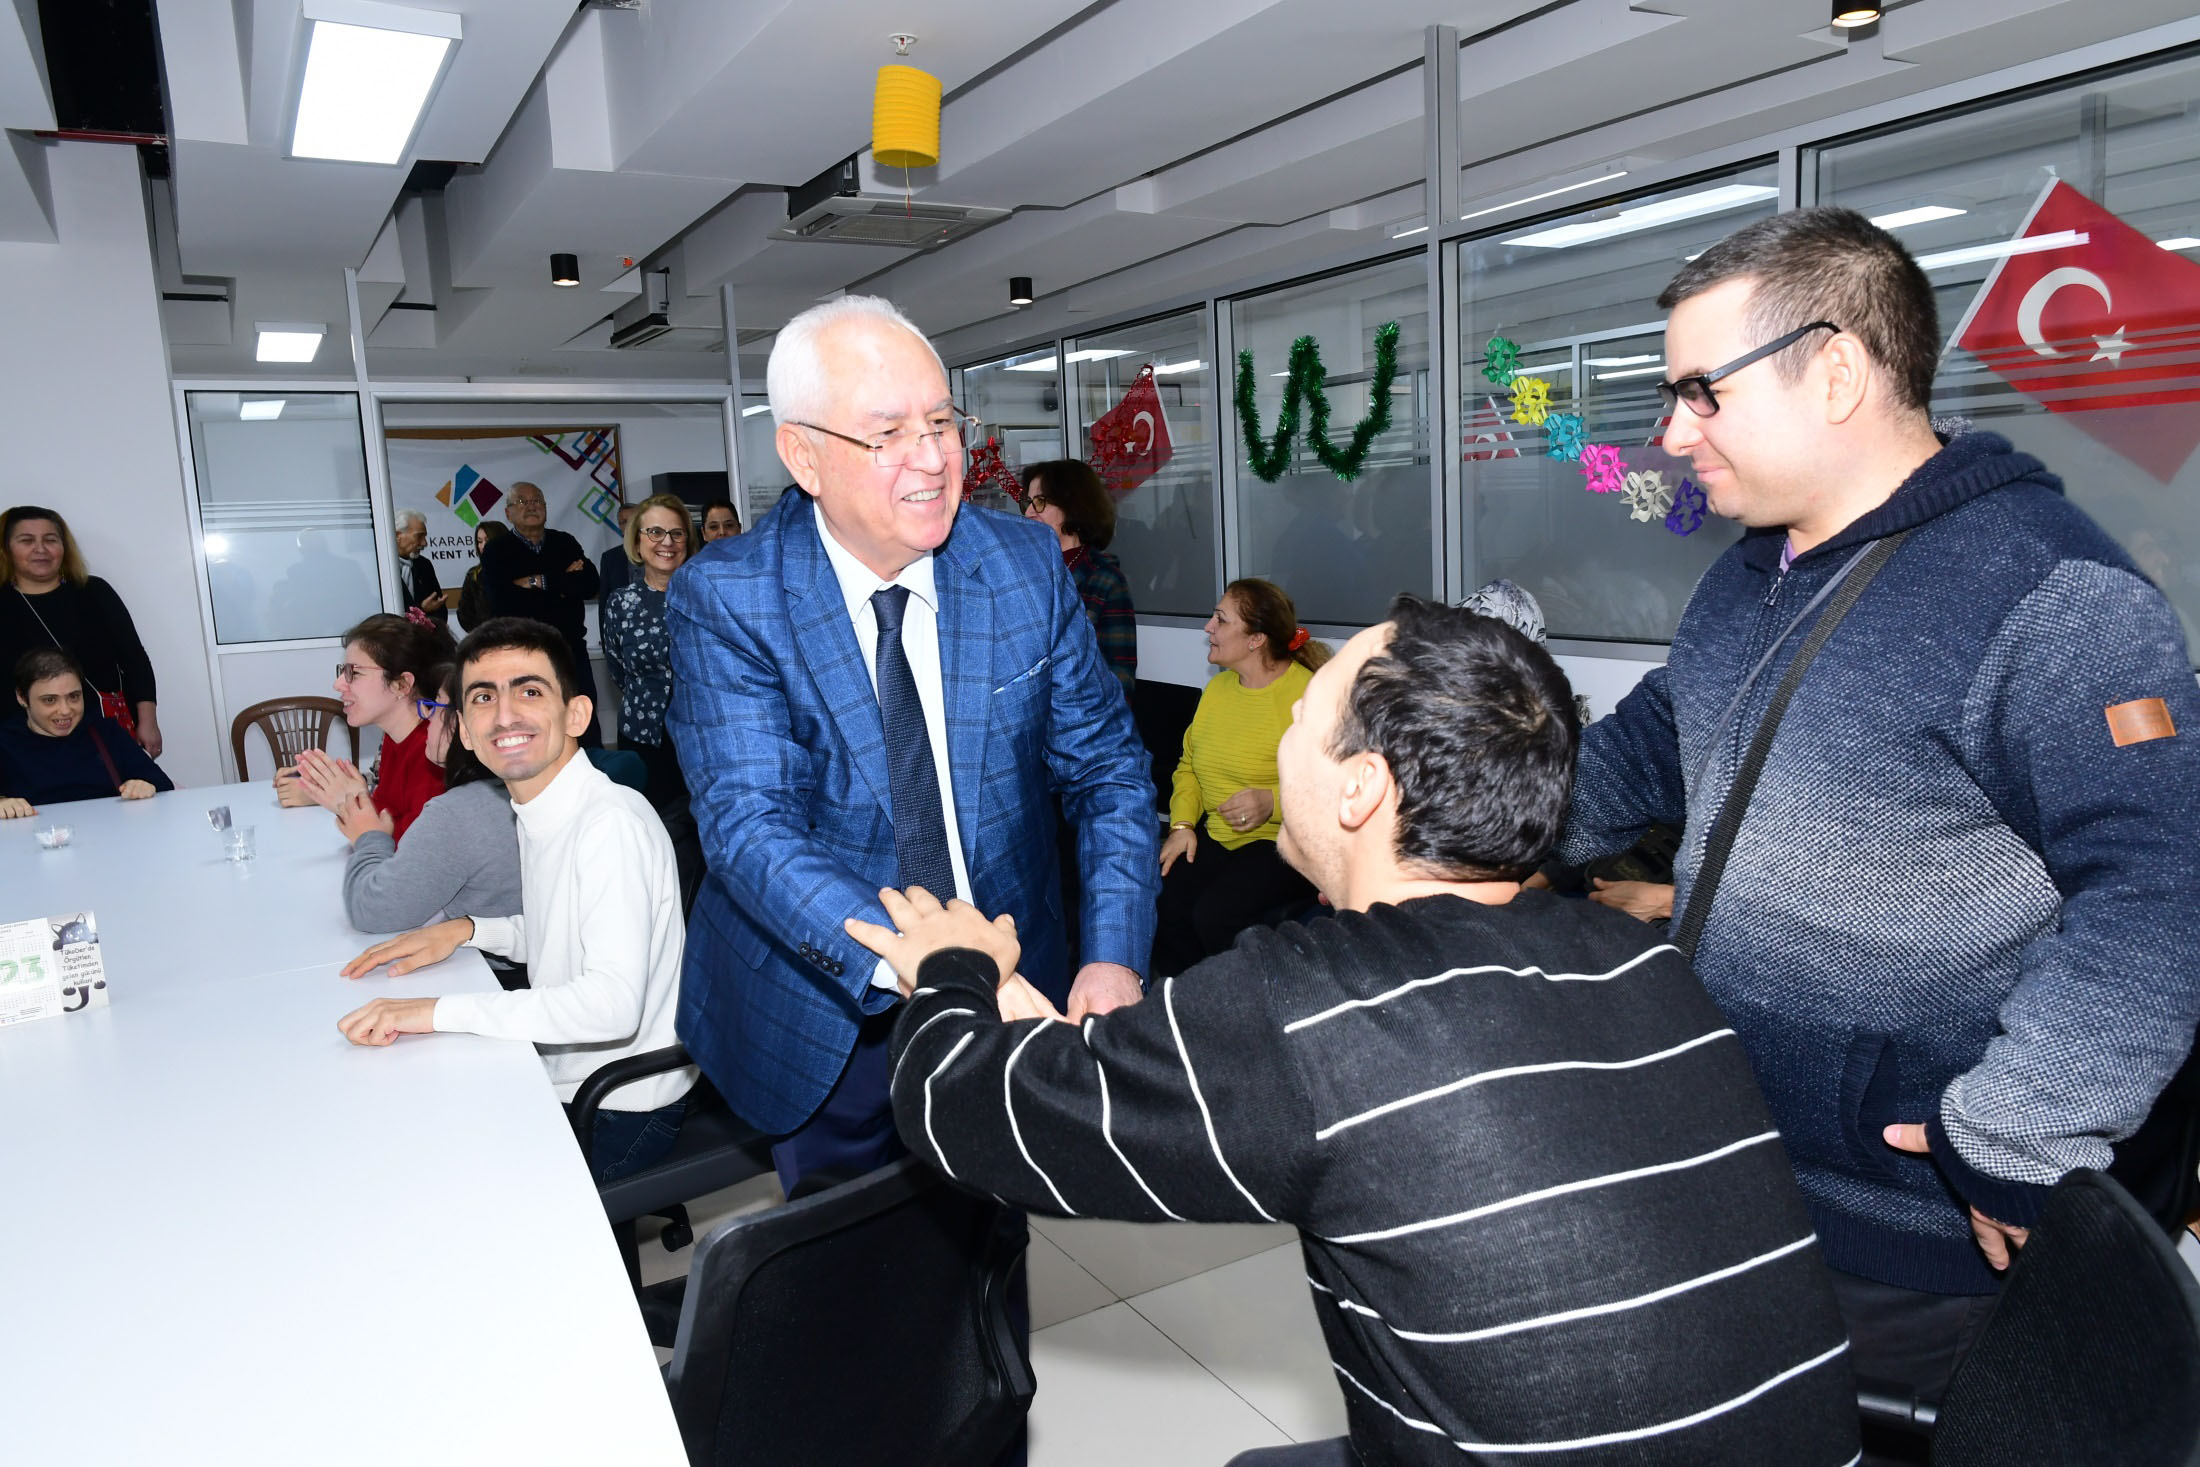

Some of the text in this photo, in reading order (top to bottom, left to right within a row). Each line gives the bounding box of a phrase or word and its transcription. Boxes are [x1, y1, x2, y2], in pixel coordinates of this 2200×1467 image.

[431, 550, 462, 560] KENT
[62, 961, 99, 971] Tüketimden
[62, 972, 79, 982] gelen
